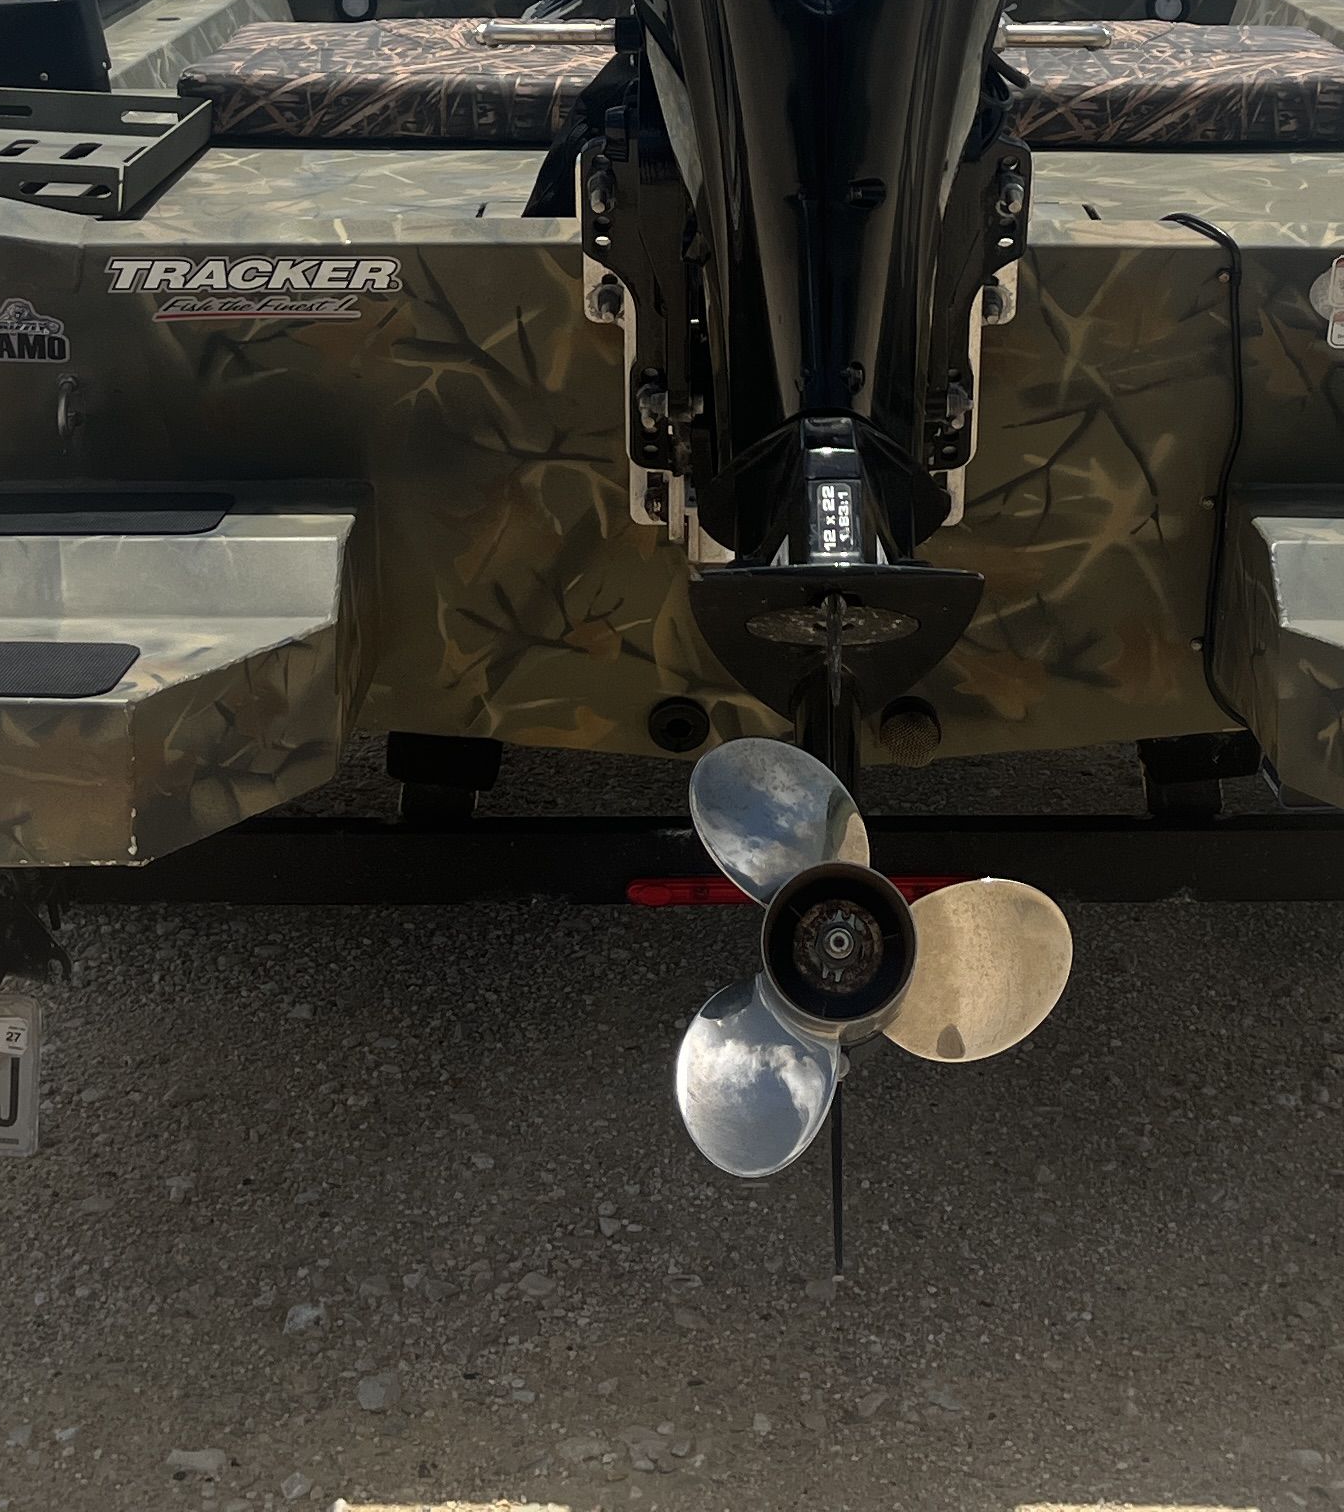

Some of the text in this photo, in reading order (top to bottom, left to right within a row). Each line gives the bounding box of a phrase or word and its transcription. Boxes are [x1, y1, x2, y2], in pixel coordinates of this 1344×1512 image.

[109, 259, 399, 289] TRACKER
[162, 298, 214, 312] Fish
[217, 300, 255, 312] the
[821, 486, 835, 511] 22
[823, 529, 836, 551] 12
[6, 1031, 22, 1043] 27
